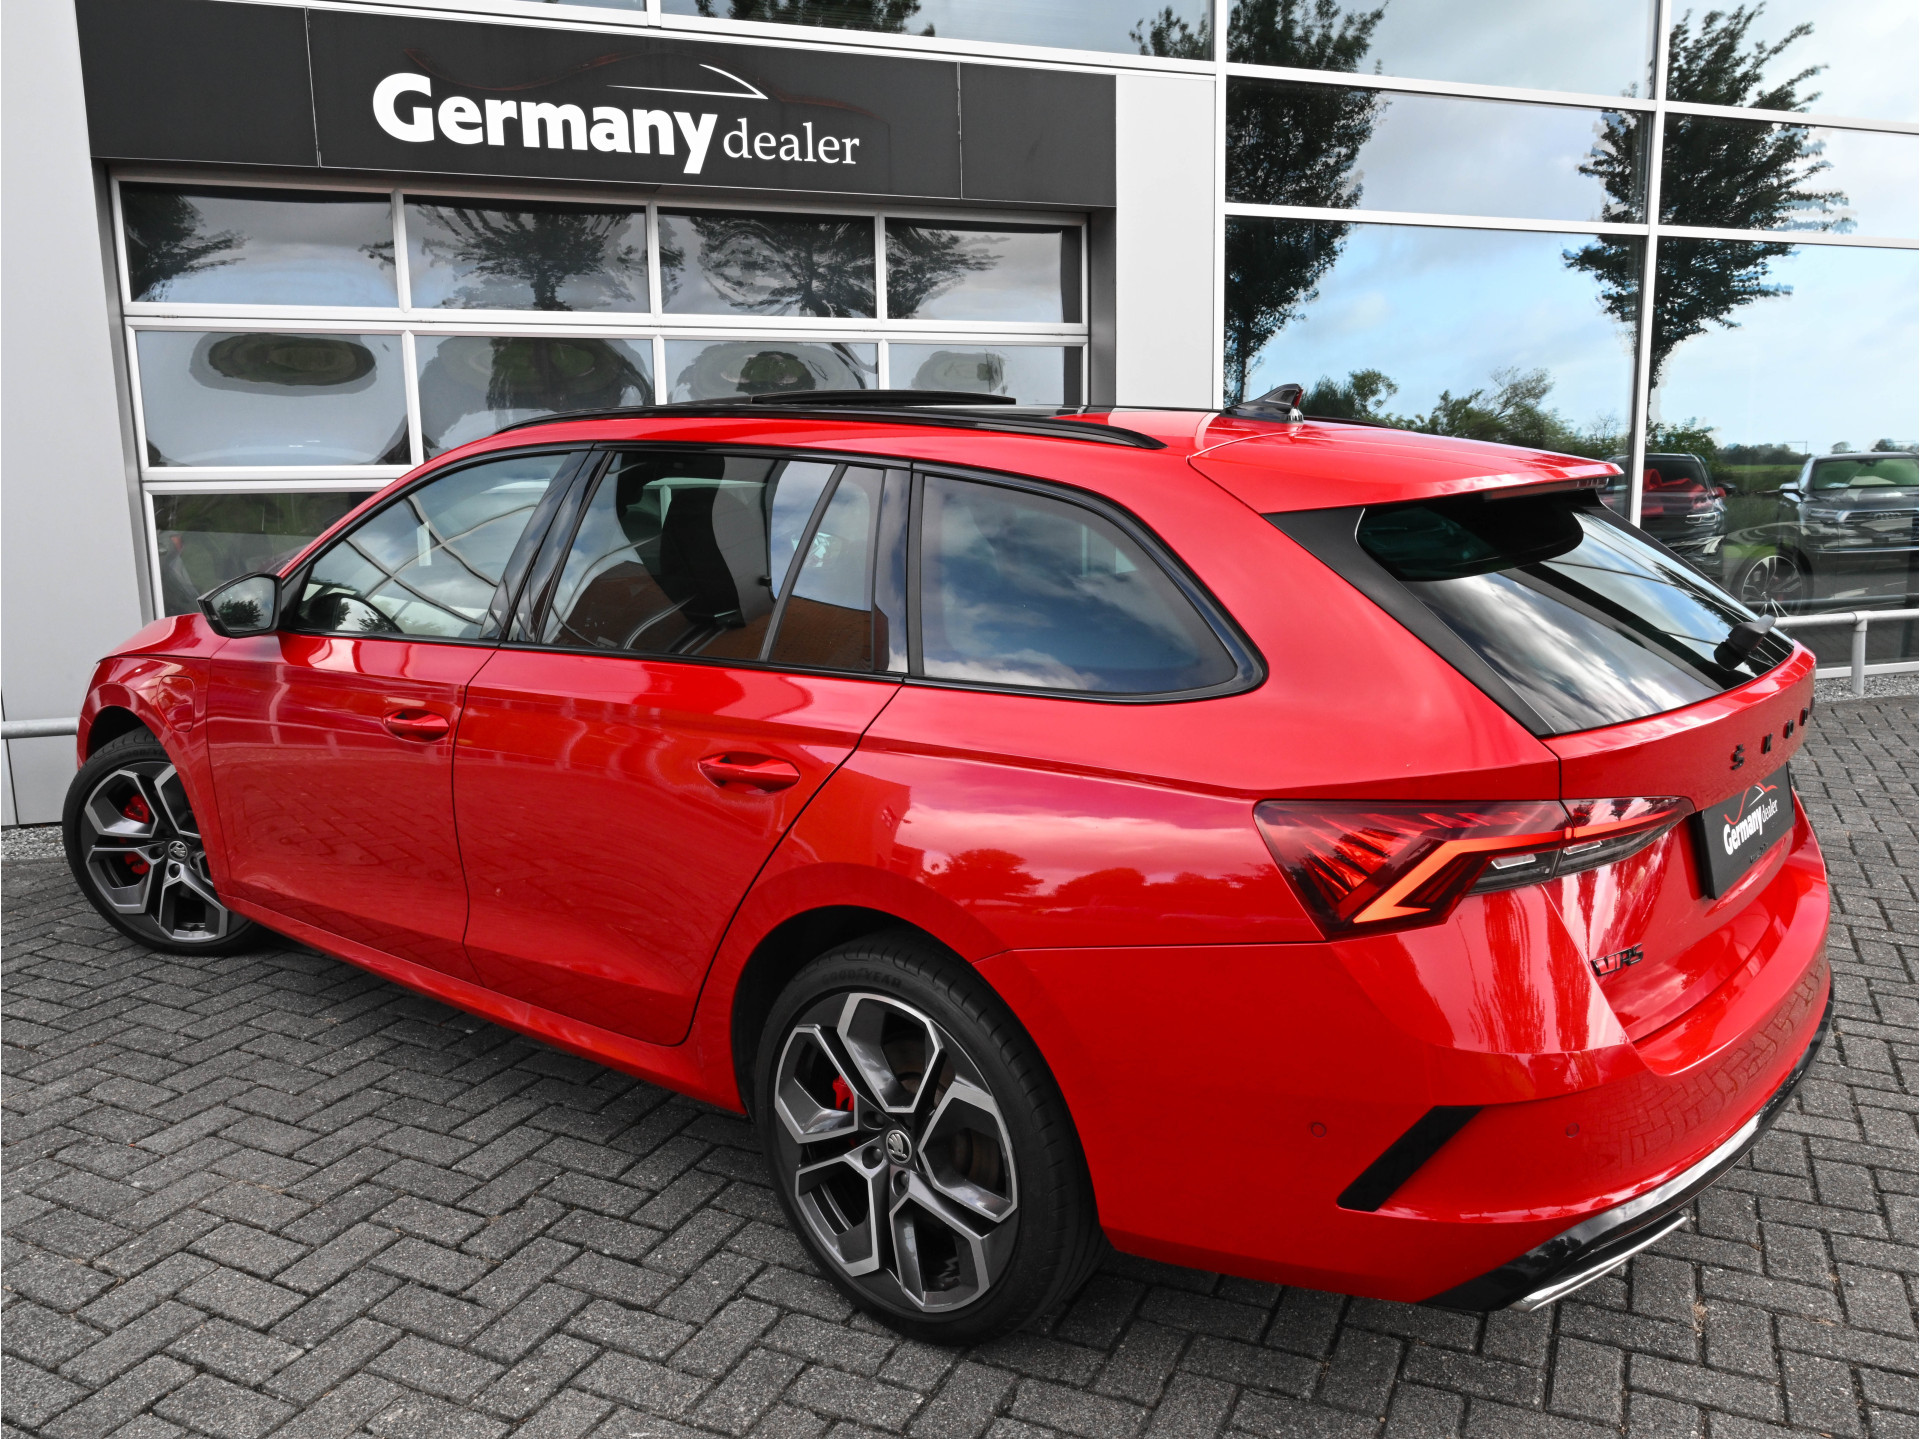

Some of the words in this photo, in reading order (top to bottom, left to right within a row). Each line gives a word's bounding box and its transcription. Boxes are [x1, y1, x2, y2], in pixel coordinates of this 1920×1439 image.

[372, 72, 718, 175] Germany
[722, 118, 860, 165] dealer
[1723, 804, 1764, 856] Germany
[1761, 798, 1778, 826] dealer
